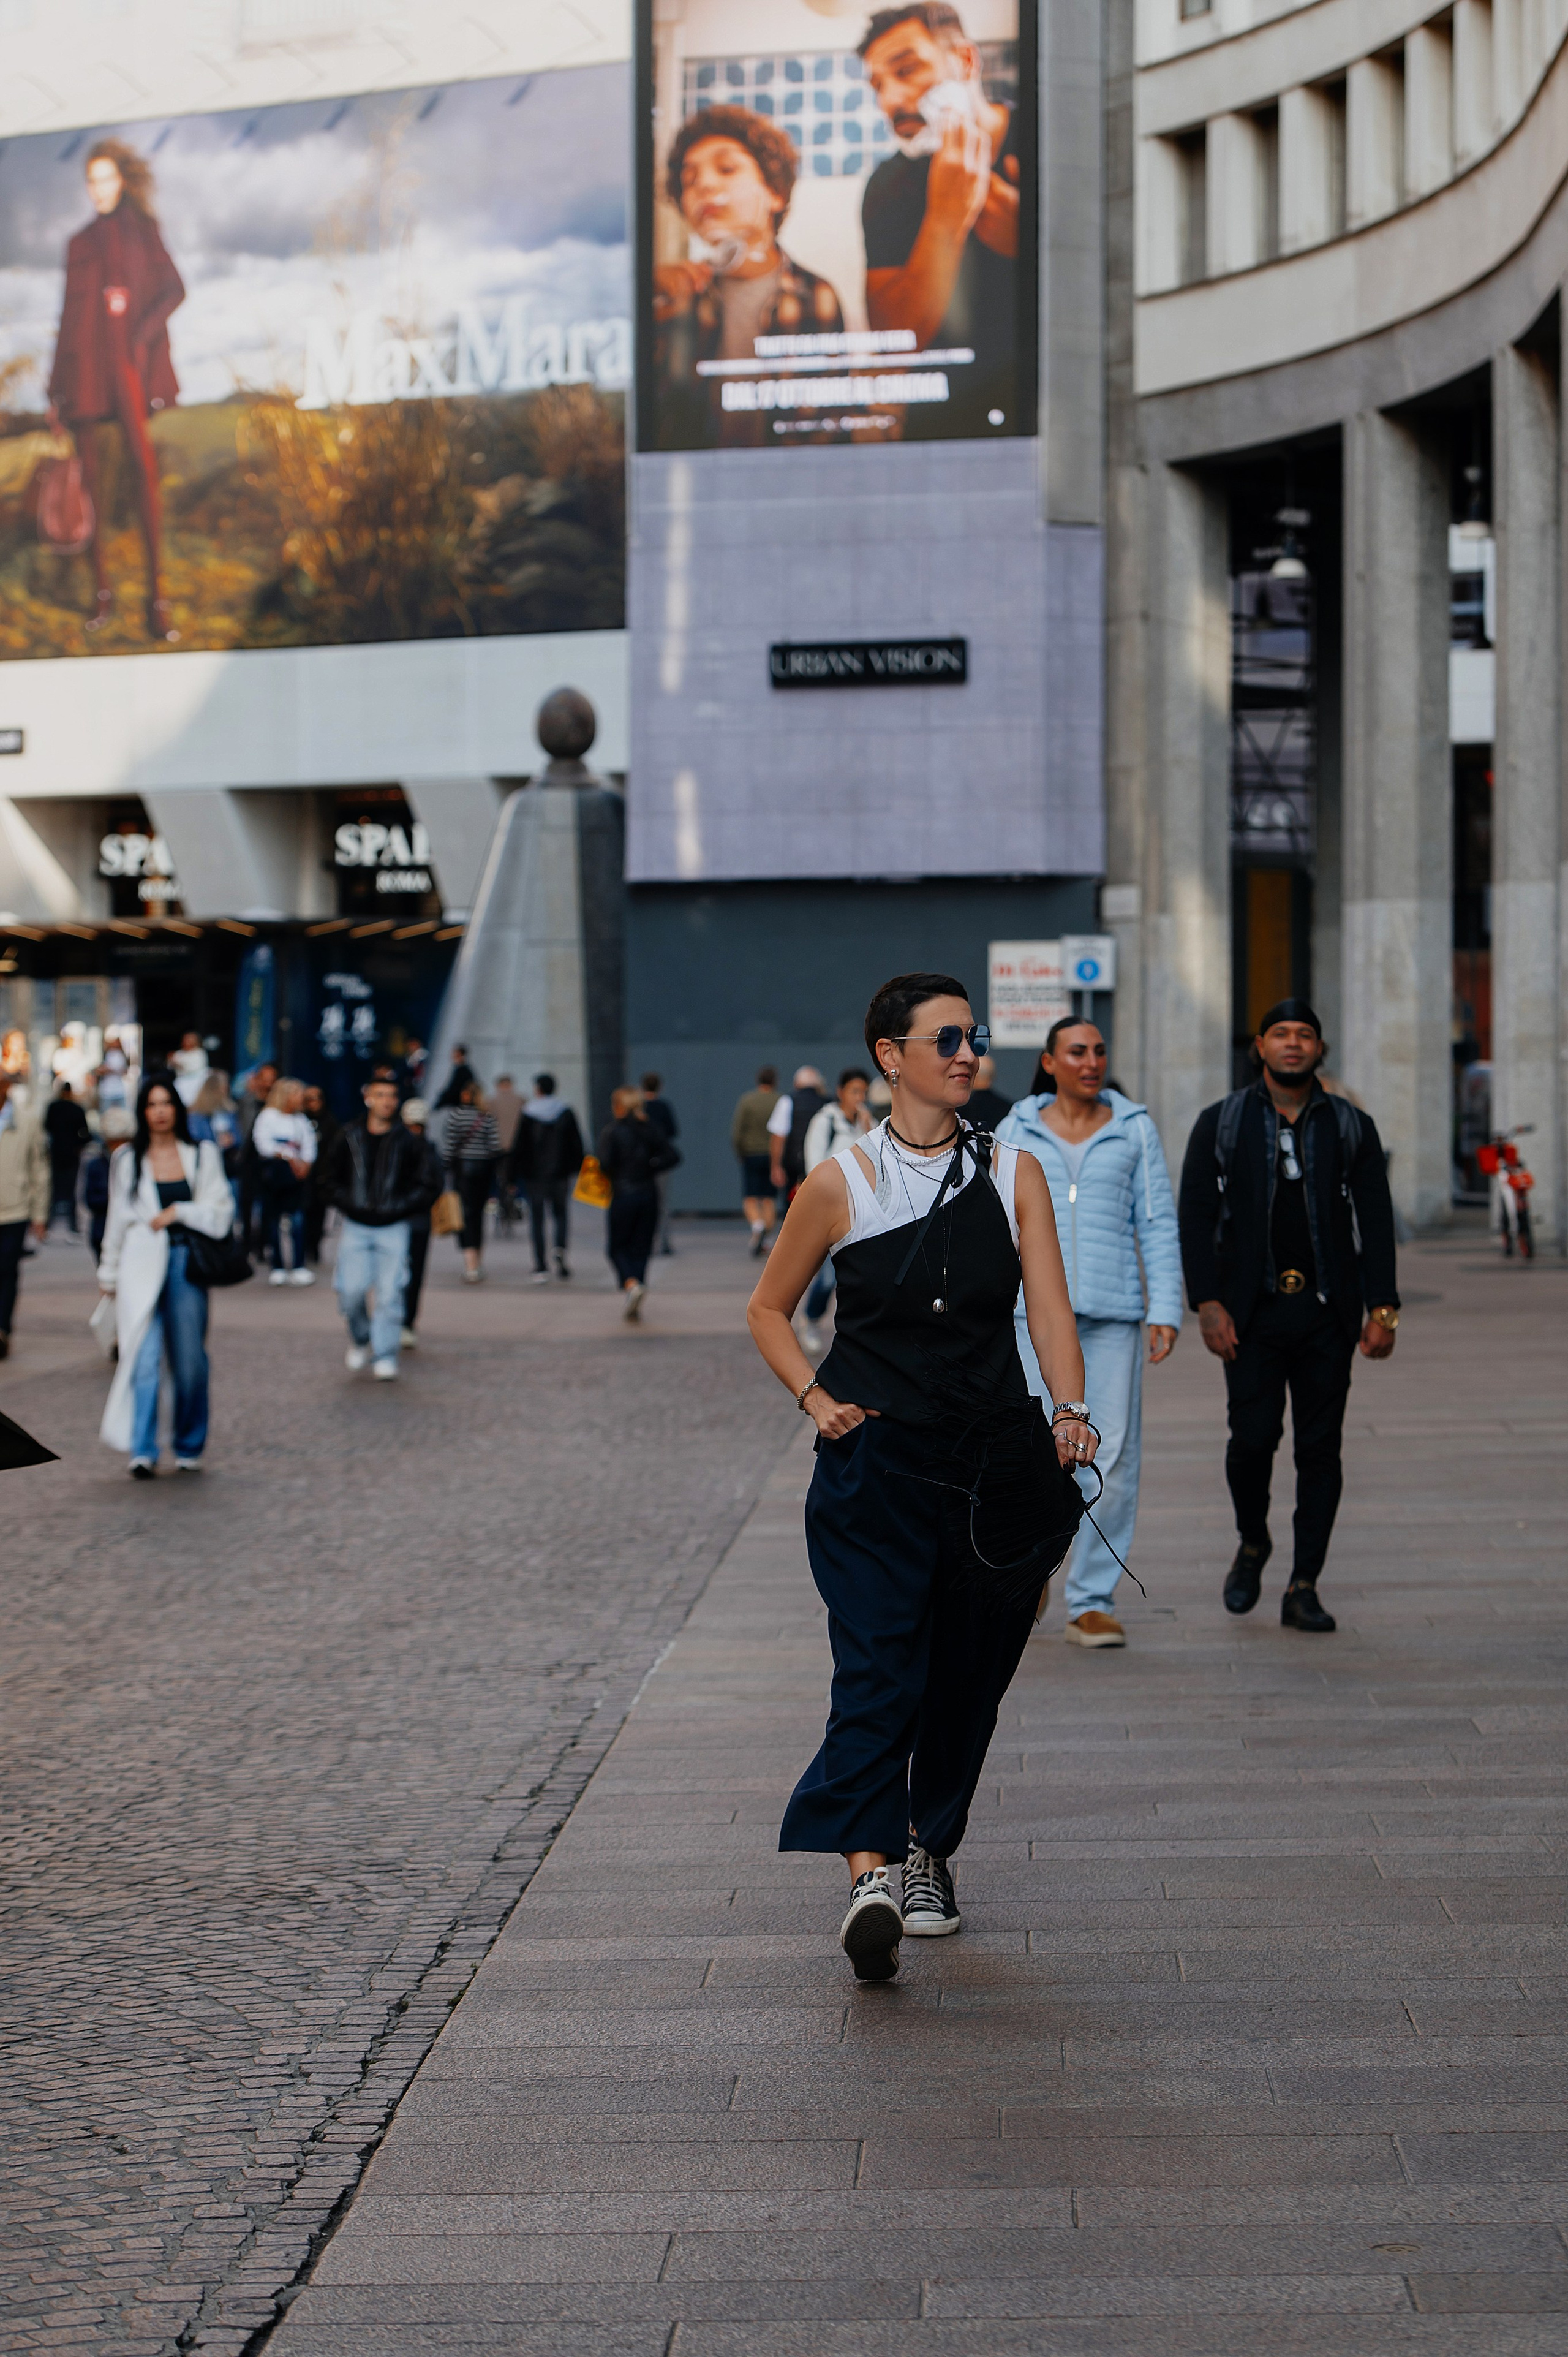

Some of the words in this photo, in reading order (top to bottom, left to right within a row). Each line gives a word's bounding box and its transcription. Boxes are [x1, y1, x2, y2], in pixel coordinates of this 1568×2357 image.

[294, 293, 634, 410] MaxMara
[772, 649, 864, 678] URBAN
[868, 646, 962, 675] VISION
